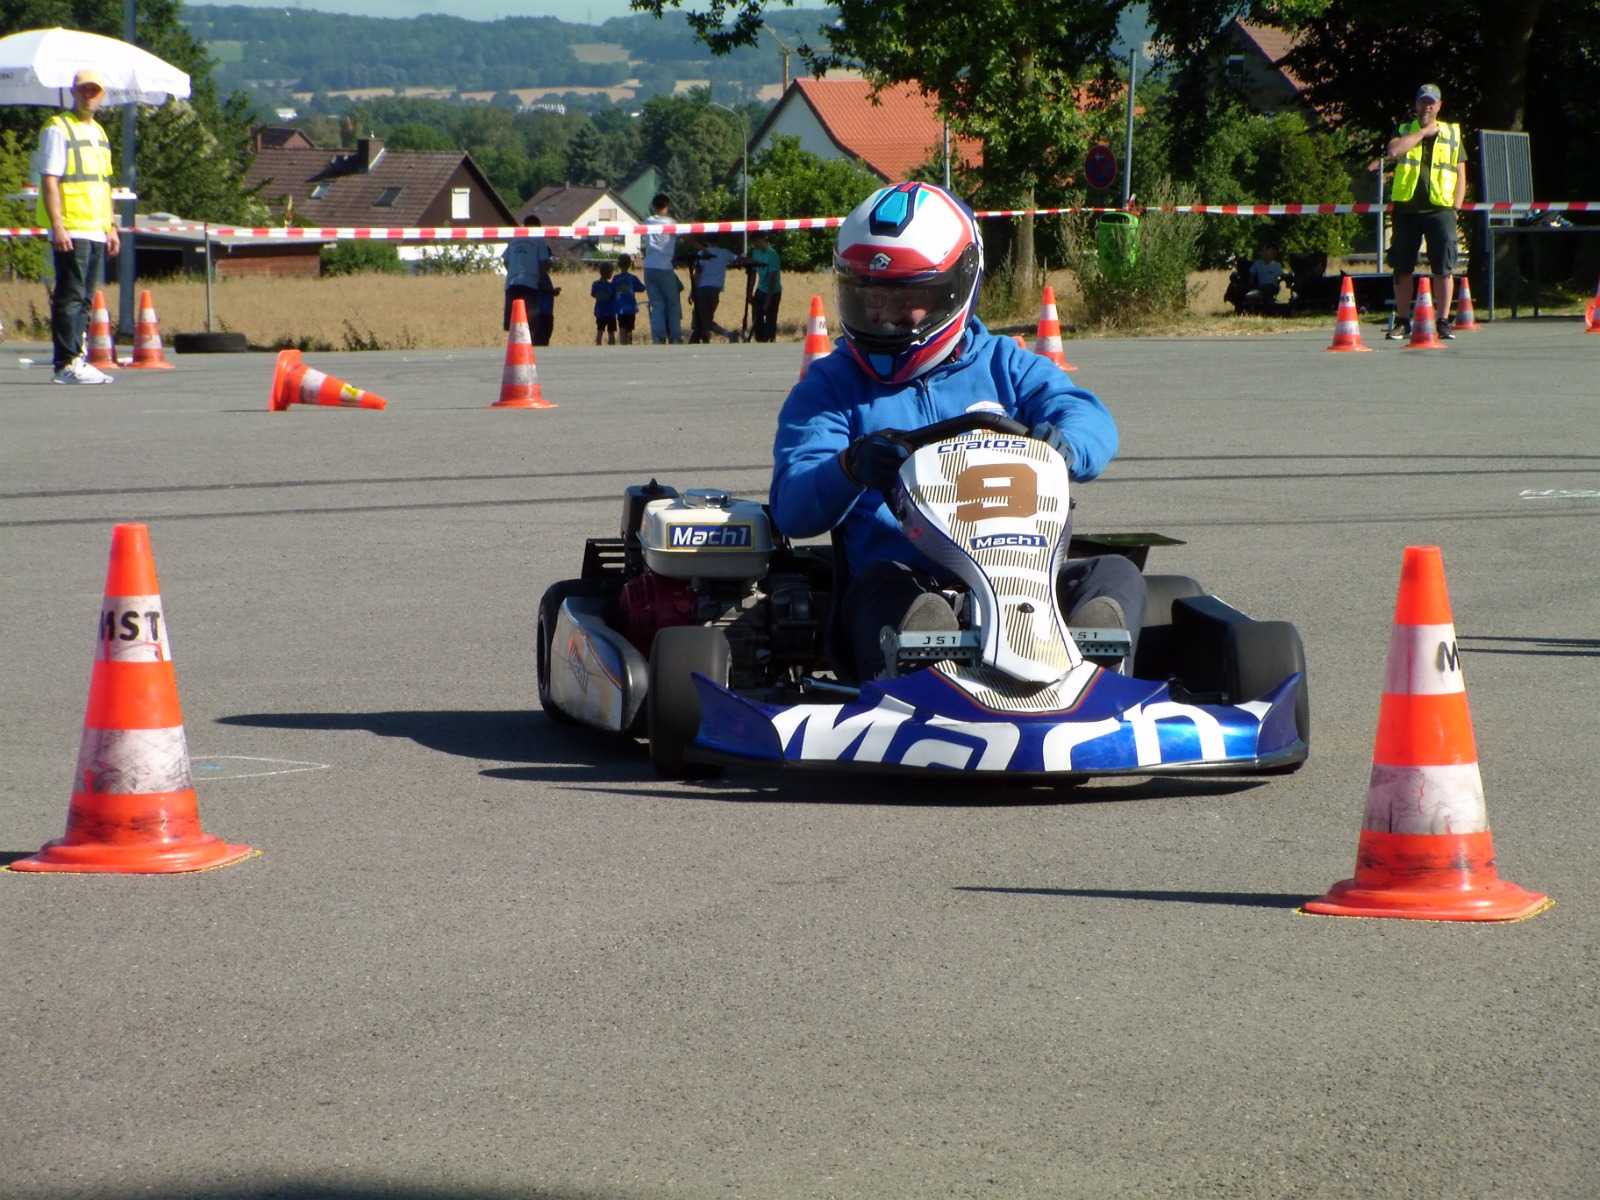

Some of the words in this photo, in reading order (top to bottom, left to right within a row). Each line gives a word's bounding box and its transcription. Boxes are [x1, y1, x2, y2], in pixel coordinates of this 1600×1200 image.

[938, 439, 1027, 454] cratos
[956, 463, 1038, 523] 9
[672, 527, 747, 545] Mach1
[975, 535, 1041, 549] Mach1
[1070, 631, 1098, 640] S1
[771, 694, 1273, 772] Mach
